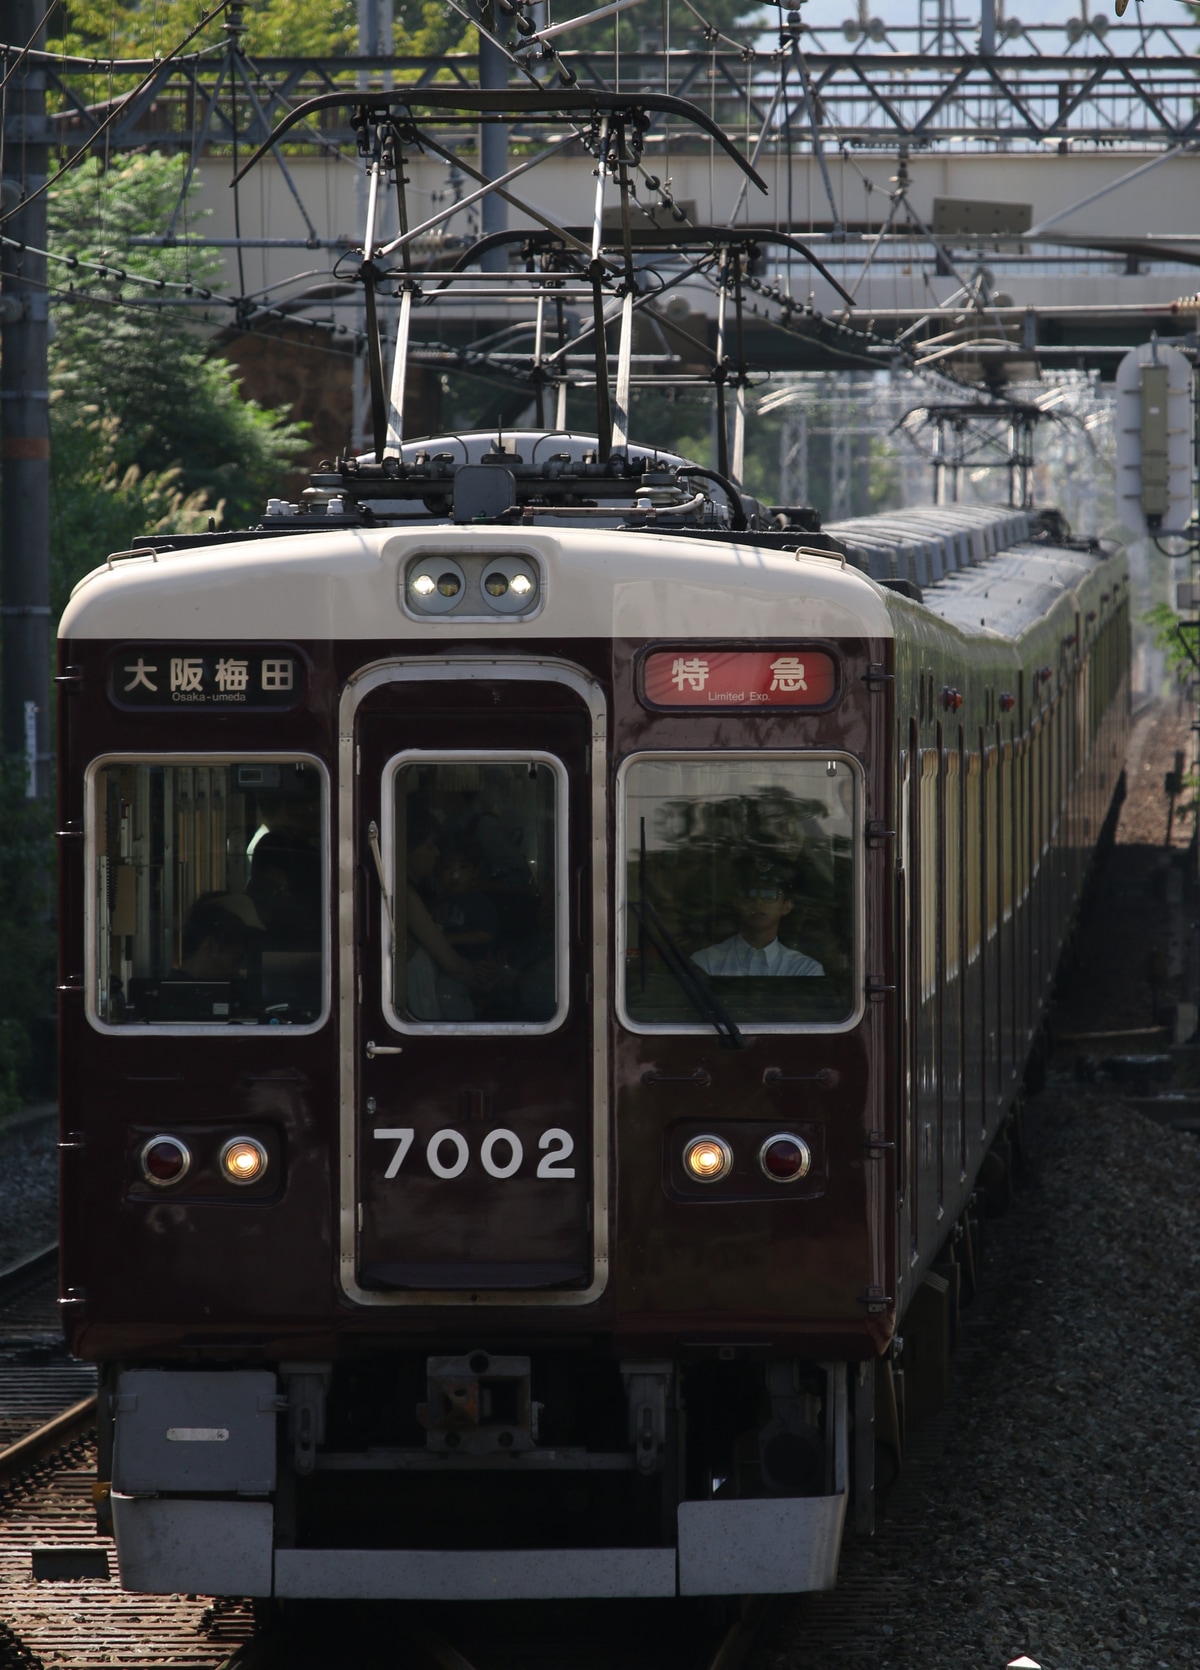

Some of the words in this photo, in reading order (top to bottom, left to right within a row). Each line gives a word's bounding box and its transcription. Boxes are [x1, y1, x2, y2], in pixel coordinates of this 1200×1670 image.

[124, 658, 293, 691] 大阪梅田
[672, 657, 807, 691] 特急
[172, 692, 246, 701] Osaka-umeda
[708, 692, 744, 701] Limited
[750, 692, 771, 702] Exp.
[374, 1128, 575, 1179] 7002
